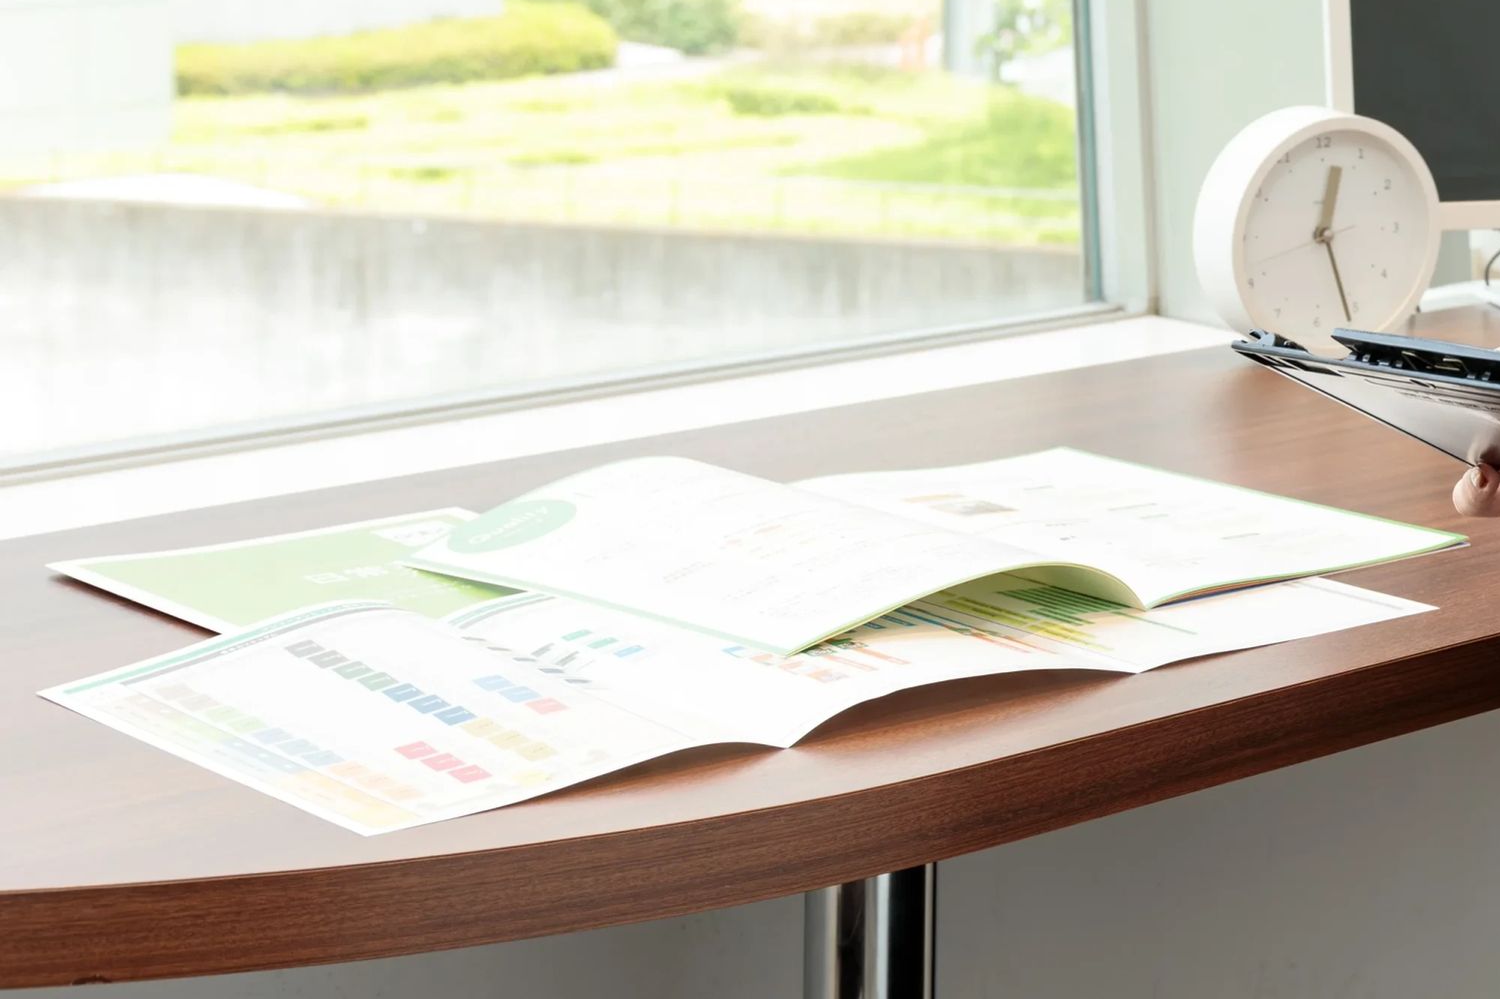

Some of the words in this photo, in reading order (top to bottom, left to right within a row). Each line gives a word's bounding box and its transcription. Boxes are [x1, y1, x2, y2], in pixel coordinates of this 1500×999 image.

[1315, 136, 1332, 149] 12
[1383, 179, 1392, 191] 2
[1392, 221, 1400, 234] 3
[1312, 316, 1321, 328] 6
